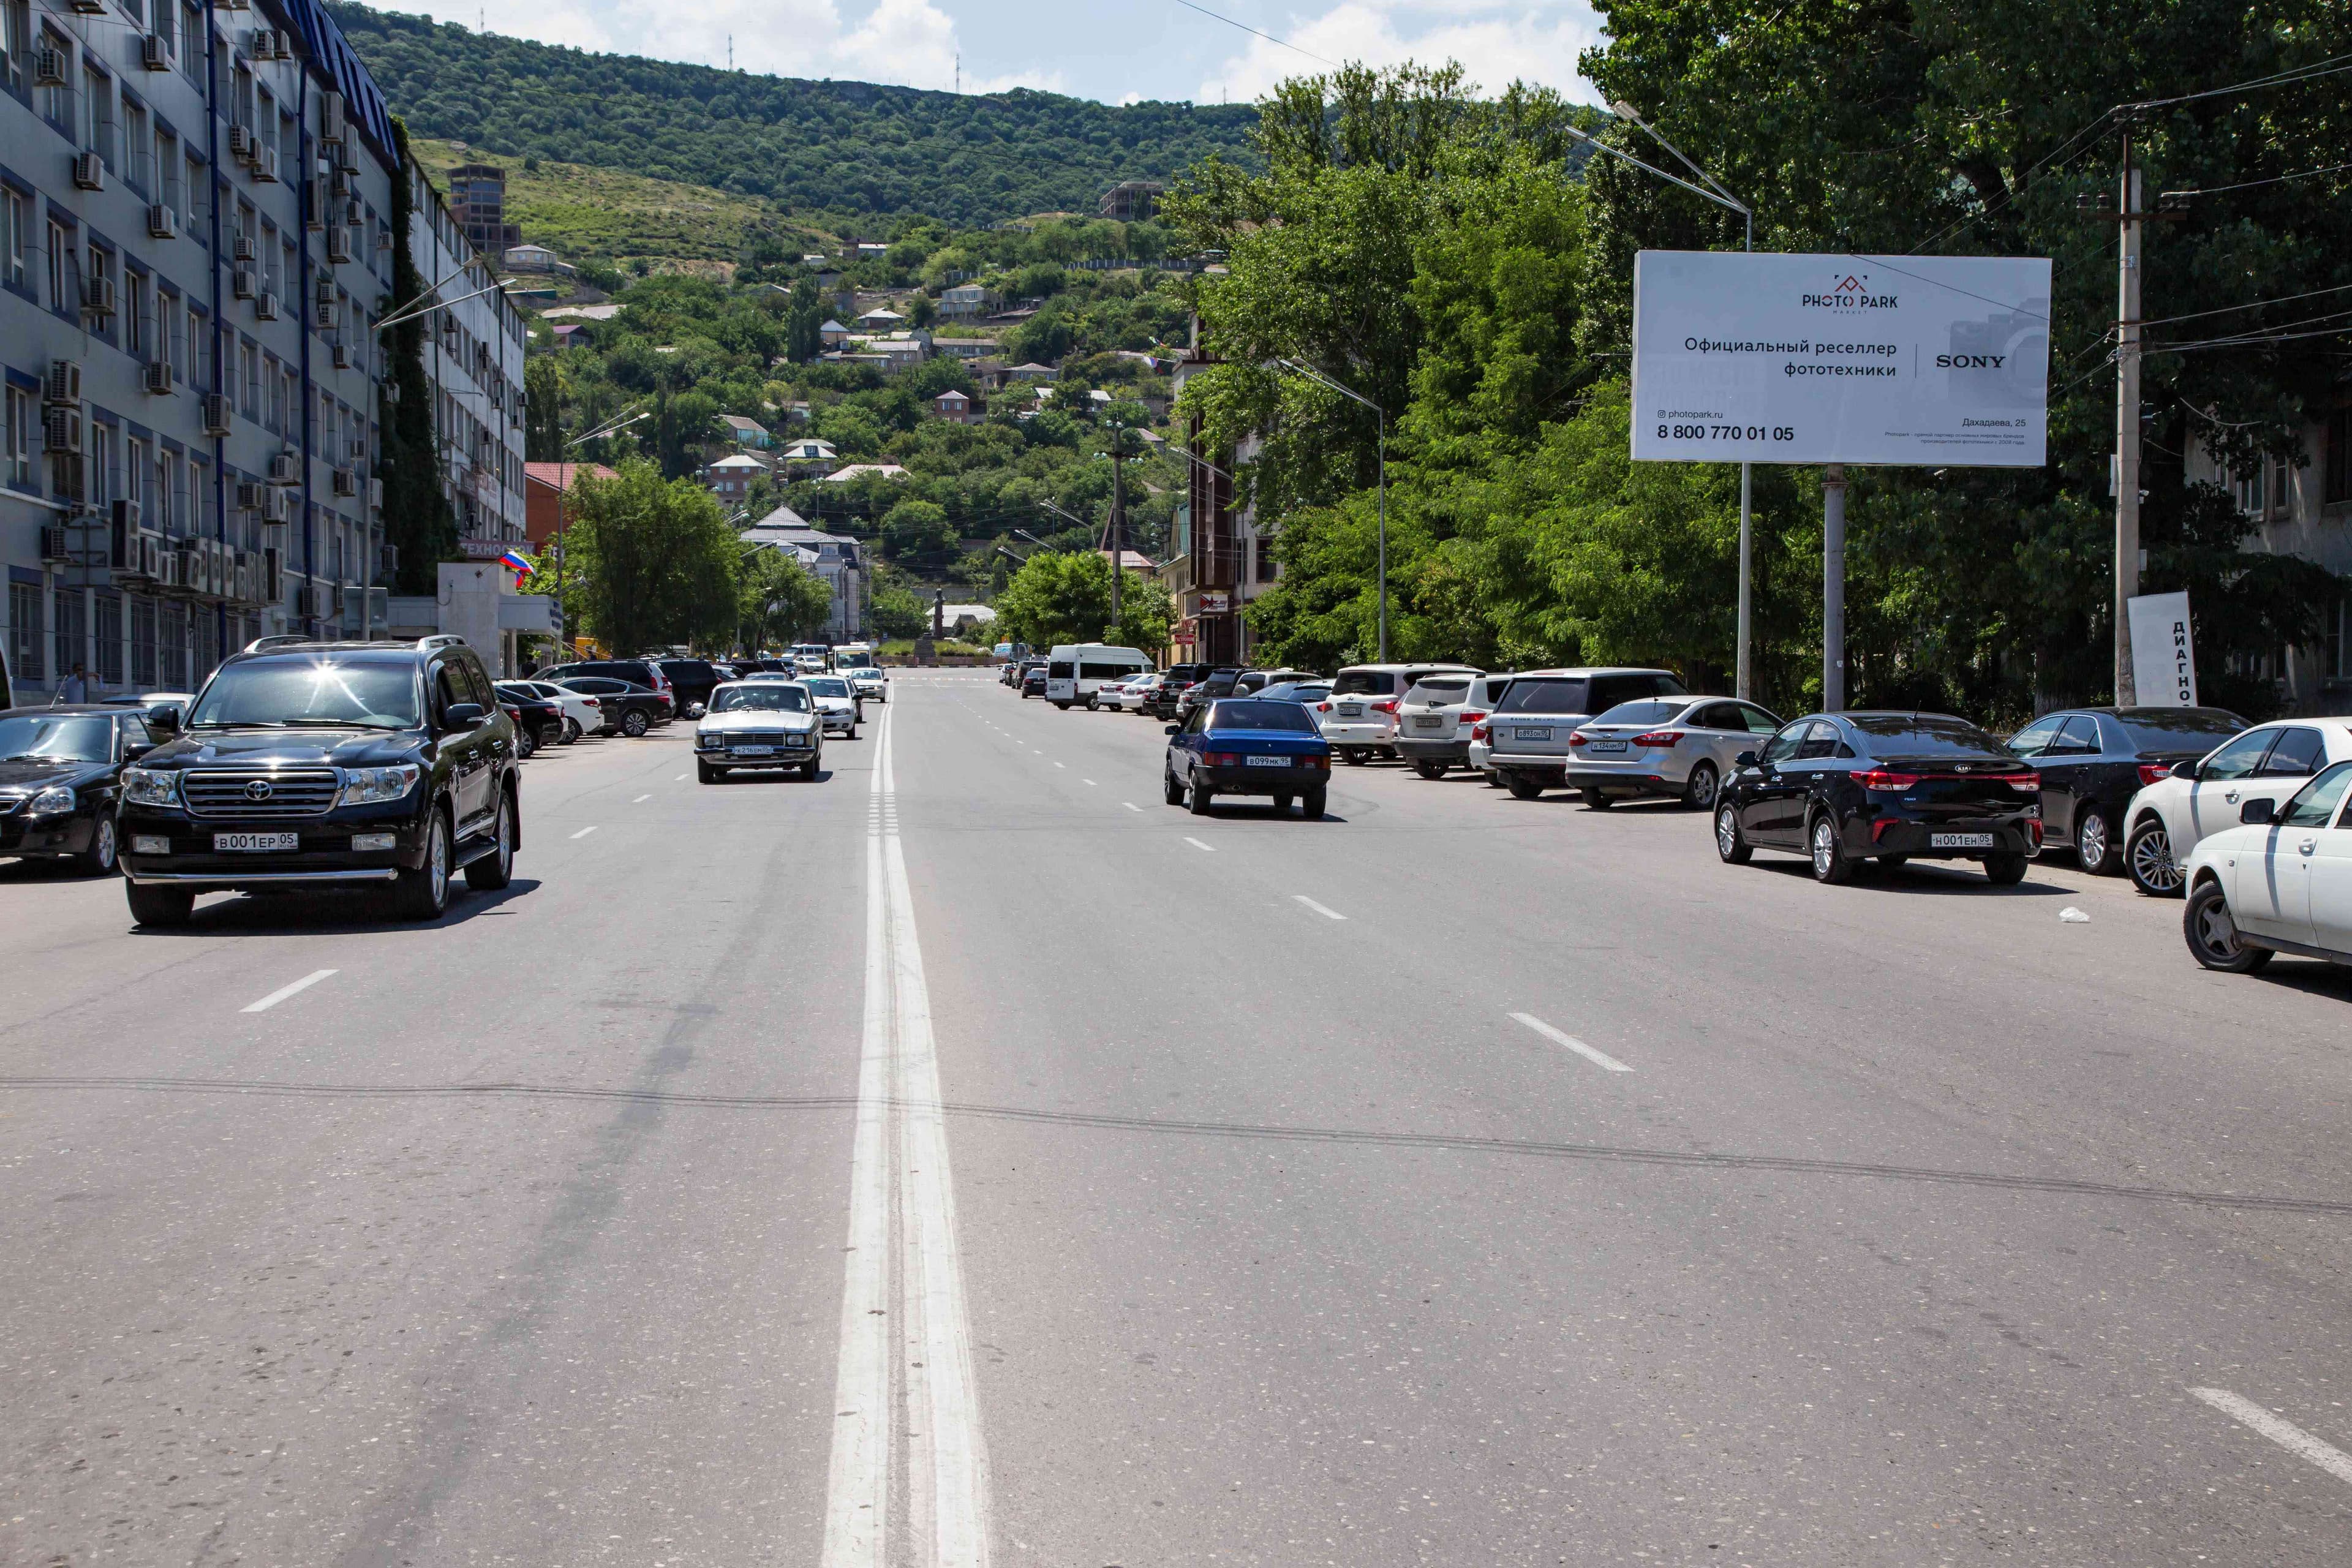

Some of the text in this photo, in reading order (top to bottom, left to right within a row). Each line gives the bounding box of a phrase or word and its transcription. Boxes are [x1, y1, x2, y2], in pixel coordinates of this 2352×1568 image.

[1803, 295, 1898, 307] PHOTO PARK
[1685, 337, 1897, 357] Официальный реселлер
[1936, 355, 2006, 368] SONY
[1784, 362, 1896, 377] фототехники
[1668, 410, 1723, 419] photopark.ru
[1962, 418, 2013, 428] Дахадаева,
[1657, 425, 1794, 440] 8 800 770 01 05
[2173, 622, 2190, 707] ДИАГНО
[280, 834, 294, 844] 05
